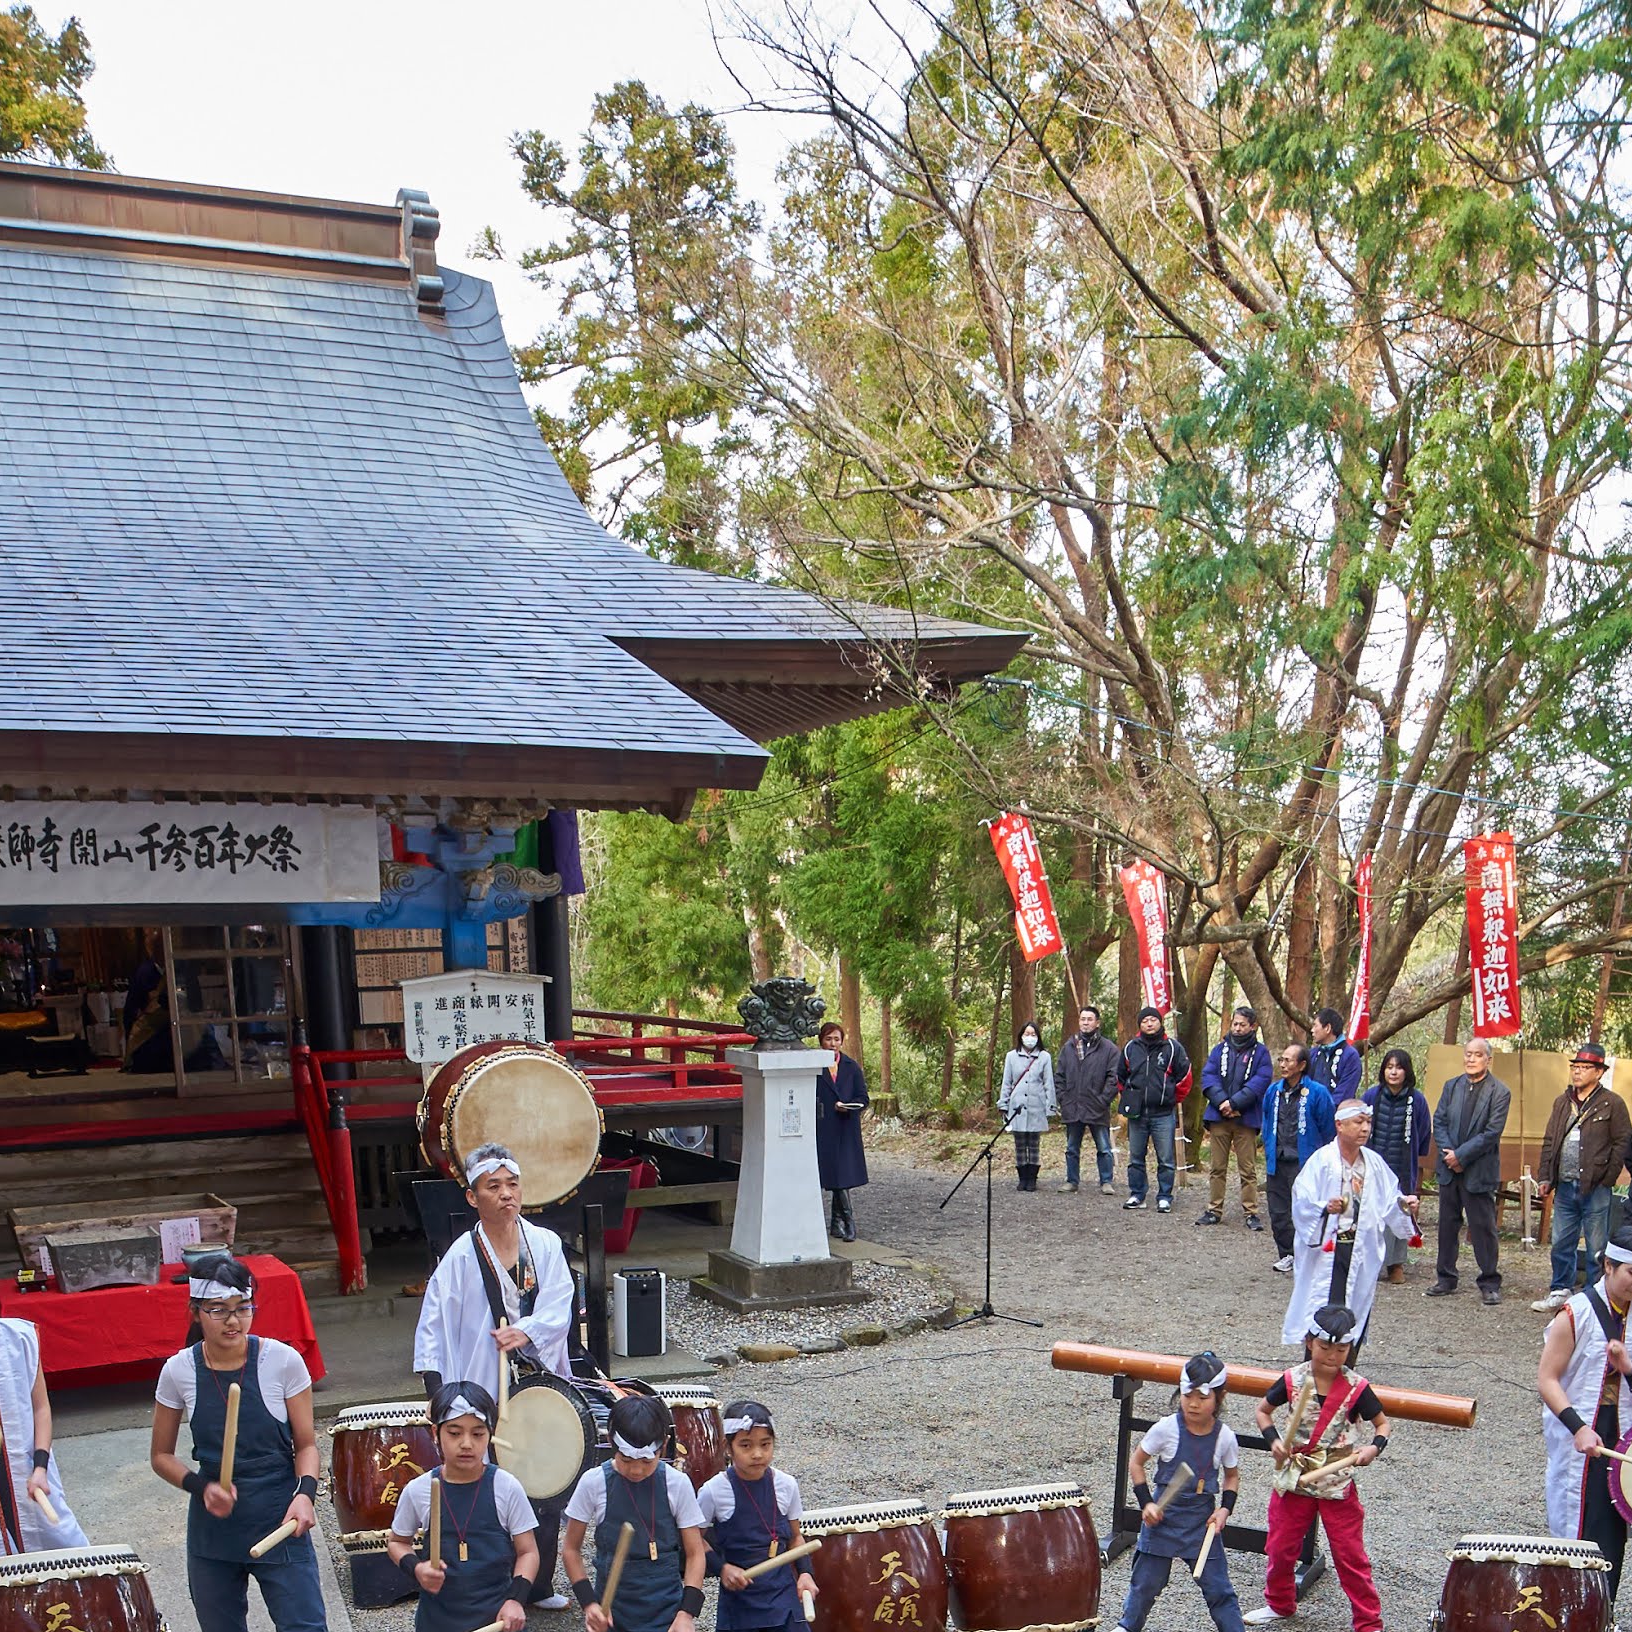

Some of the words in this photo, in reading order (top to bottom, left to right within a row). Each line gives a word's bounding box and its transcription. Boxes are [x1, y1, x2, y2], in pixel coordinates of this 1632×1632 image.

[1480, 861, 1512, 1025] 南無釈迦如来
[870, 1551, 923, 1627] 天領
